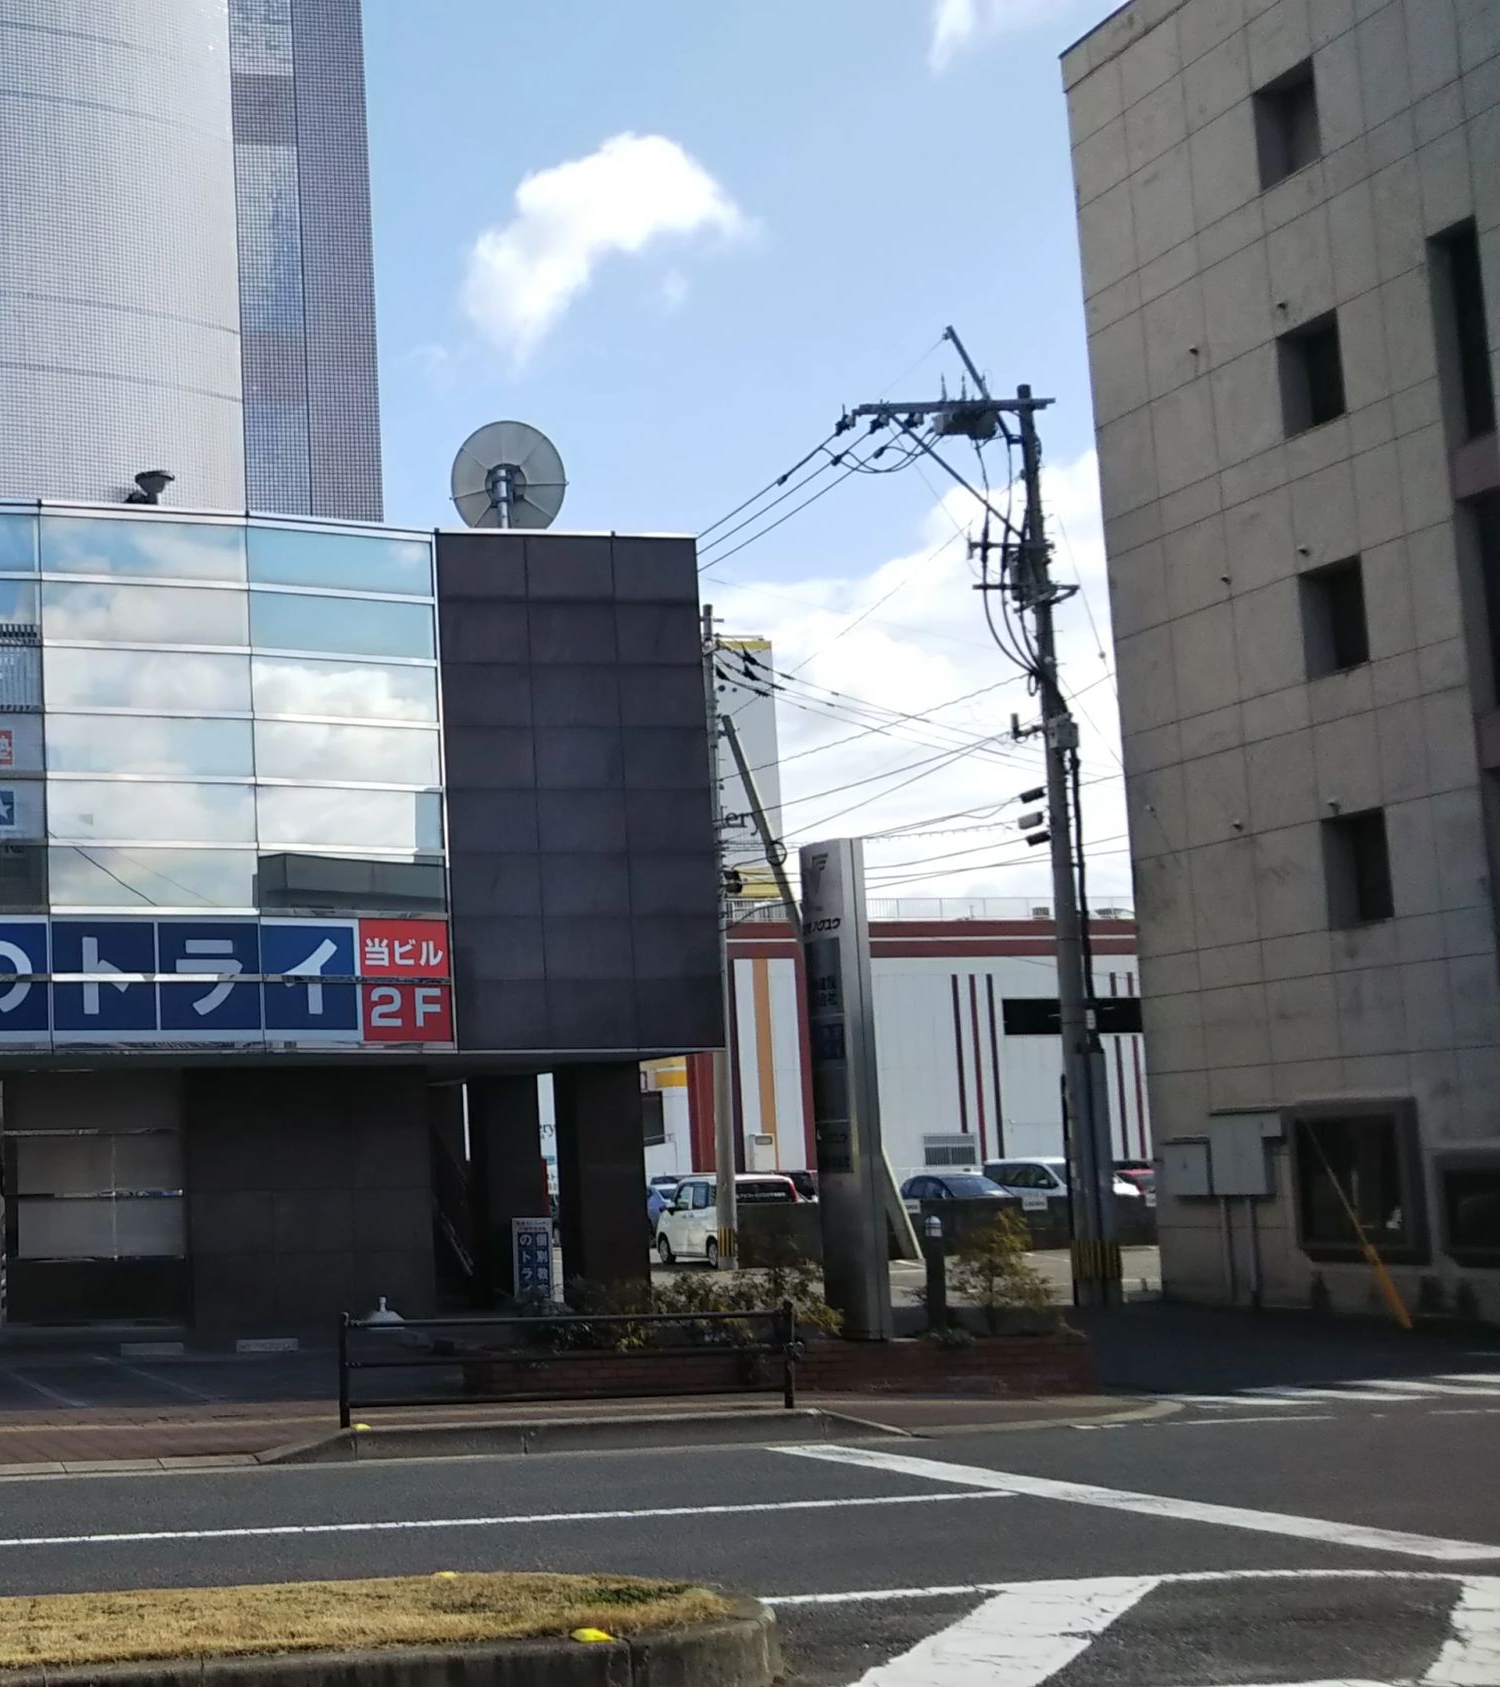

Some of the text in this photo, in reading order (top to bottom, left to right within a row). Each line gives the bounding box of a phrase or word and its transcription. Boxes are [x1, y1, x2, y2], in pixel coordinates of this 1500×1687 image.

[365, 937, 444, 967] 当ビル
[371, 986, 442, 1028] 2F
